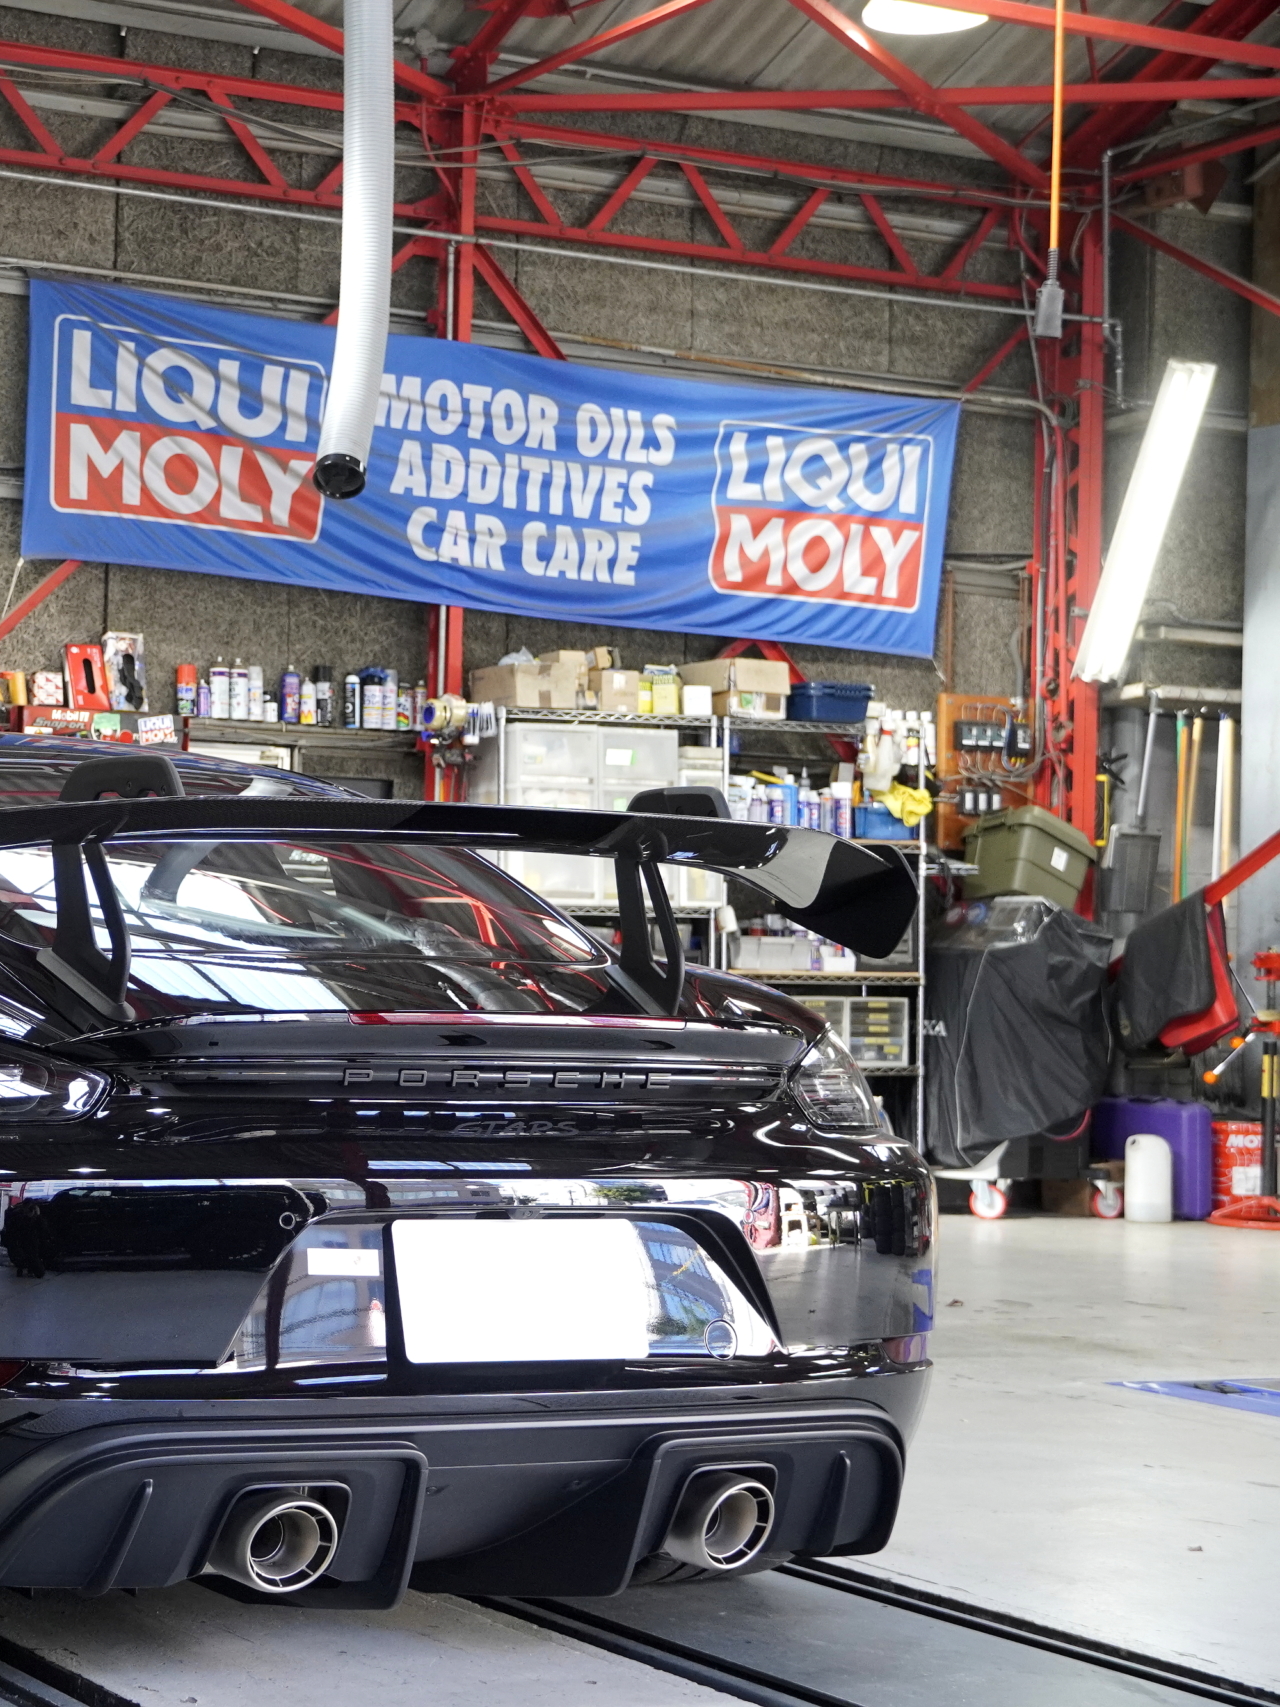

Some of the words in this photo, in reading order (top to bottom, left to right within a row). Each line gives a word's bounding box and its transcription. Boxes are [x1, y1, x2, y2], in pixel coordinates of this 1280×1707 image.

[71, 329, 310, 442] LIQUI
[374, 373, 559, 452] MOTOR
[576, 402, 678, 466] OILS
[70, 423, 314, 528] MOLY
[389, 439, 654, 526] ADDITIVES
[726, 431, 922, 514] LIQUI
[406, 506, 508, 572] CAR
[521, 520, 642, 586] CARE
[723, 513, 920, 599] MOLY
[33, 716, 85, 730] Snap-on
[51, 709, 79, 722] Mobil
[141, 717, 172, 732] LIQUI
[343, 1068, 672, 1089] PORSCHE
